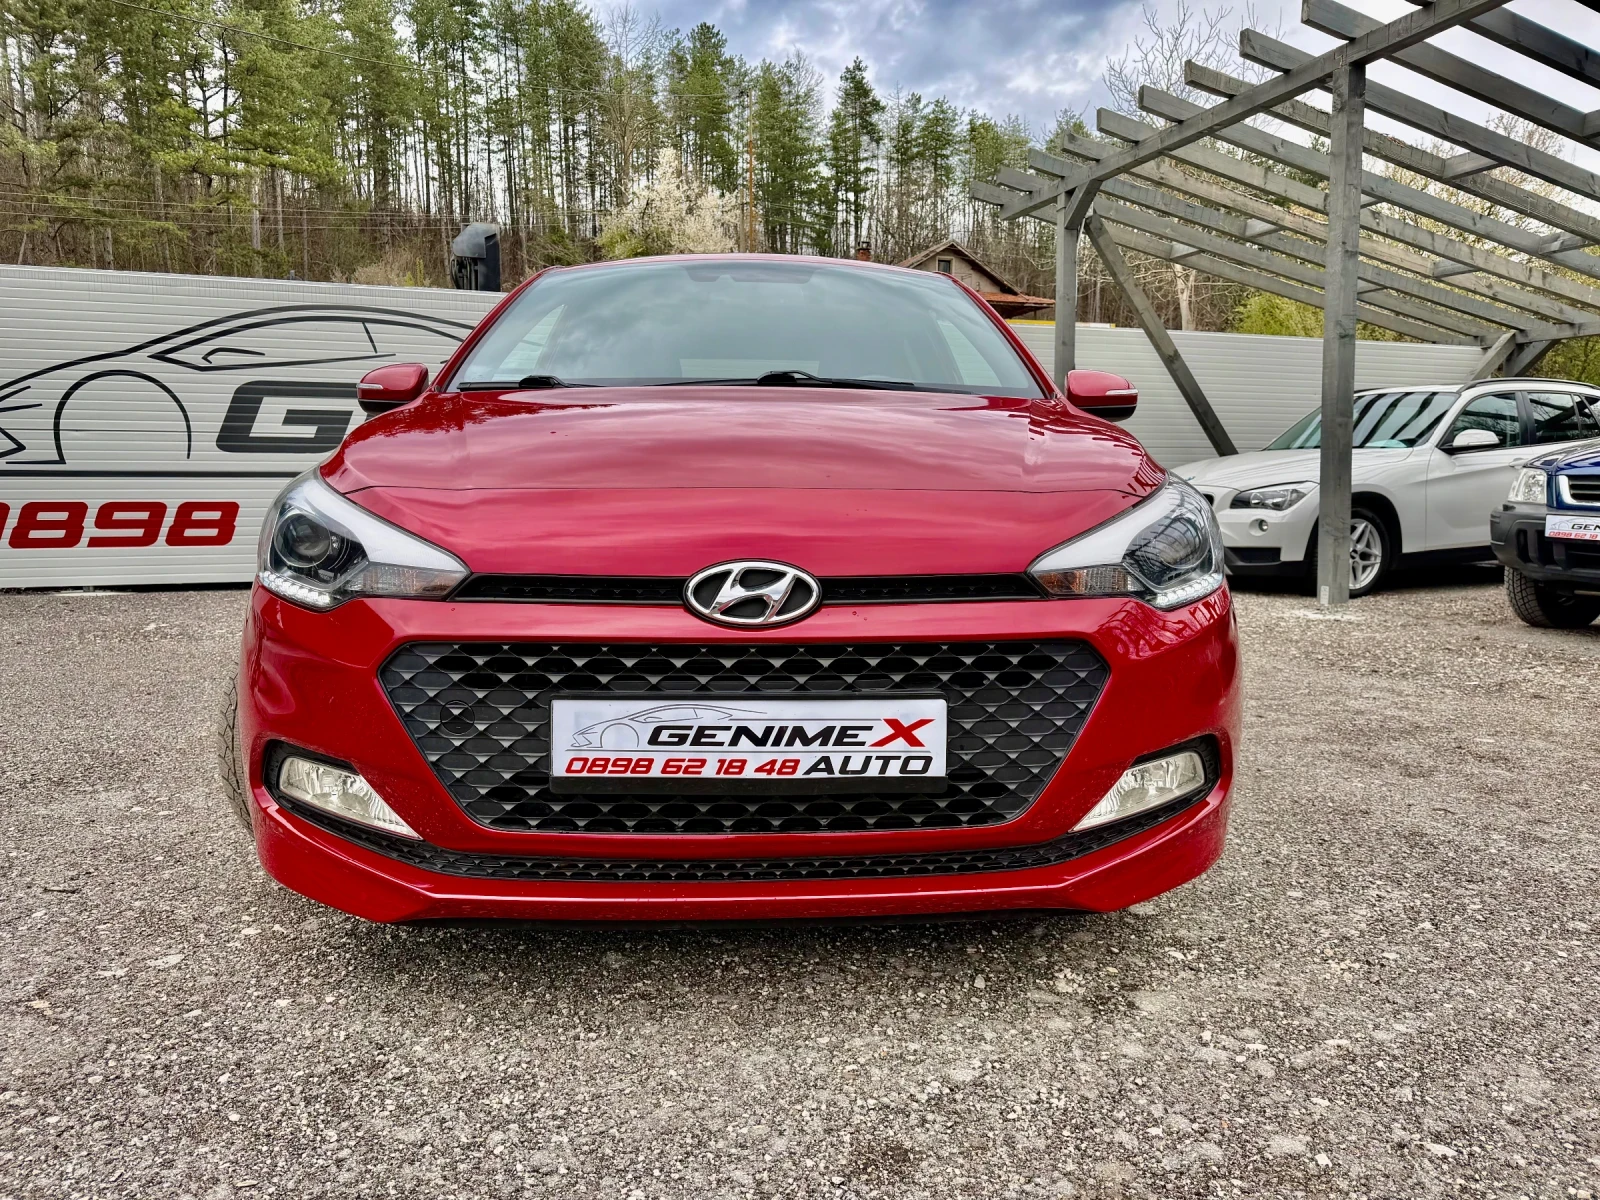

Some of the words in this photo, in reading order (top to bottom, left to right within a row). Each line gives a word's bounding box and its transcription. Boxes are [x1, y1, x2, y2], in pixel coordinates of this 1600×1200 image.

[0, 501, 240, 549] 898
[647, 718, 935, 748] GENIMEX
[565, 757, 655, 775] 0898
[660, 758, 708, 775] 62
[715, 758, 748, 776] 18
[753, 758, 801, 776] 48
[802, 755, 934, 776] AUTO
